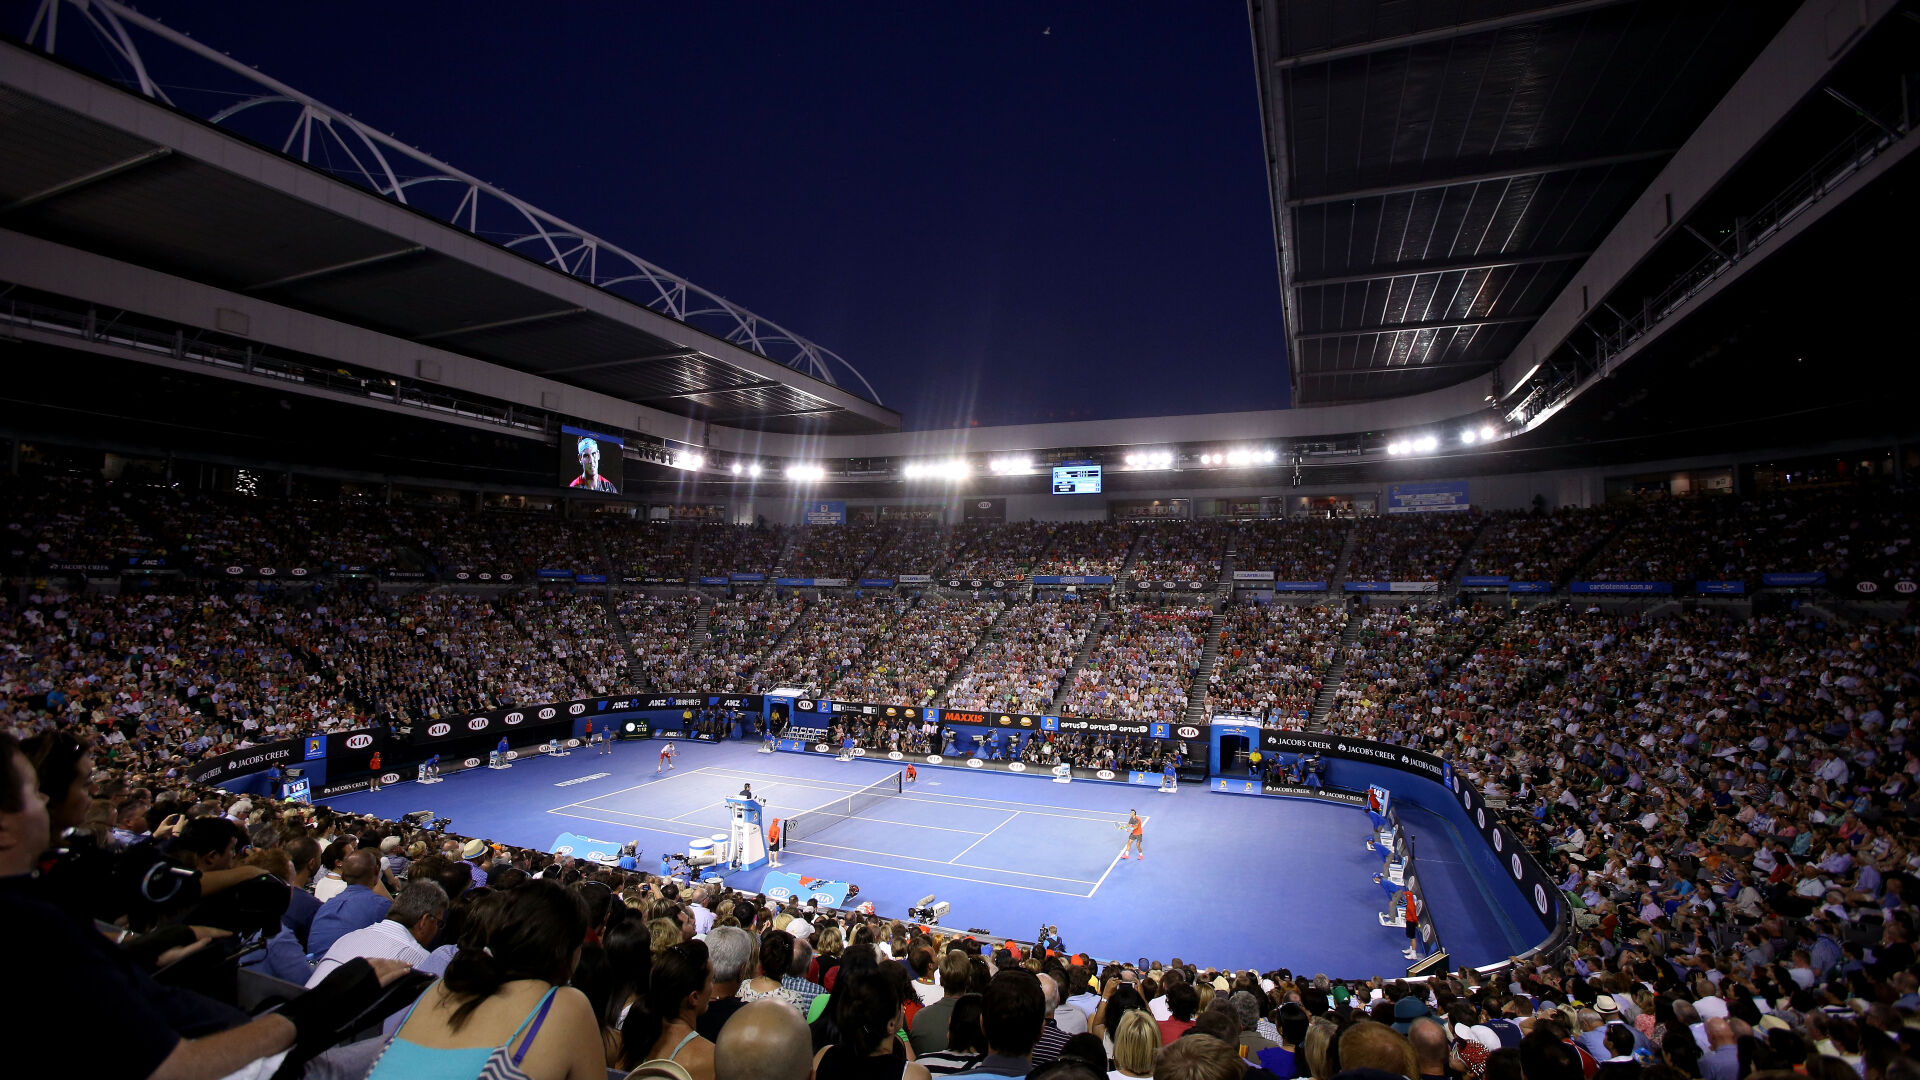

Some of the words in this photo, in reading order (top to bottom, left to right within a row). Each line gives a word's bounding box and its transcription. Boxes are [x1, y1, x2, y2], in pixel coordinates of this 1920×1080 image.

[1858, 583, 1875, 591] KIA
[1897, 583, 1914, 591] KIA
[611, 701, 630, 710] ANZ
[648, 699, 667, 707] ANZ
[723, 699, 741, 707] ANZ
[540, 709, 554, 717] KIA
[570, 705, 584, 713] KIA
[507, 714, 522, 723] KIA
[945, 712, 983, 723] MAXXIS
[470, 719, 487, 728] KIA
[1060, 721, 1081, 729] OPTUS
[1089, 724, 1110, 732] OPTUS
[1119, 725, 1140, 733] OPTUS
[431, 725, 447, 734] KIA
[1181, 728, 1197, 736] KIA
[350, 735, 371, 748] KIA
[1277, 738, 1306, 747] JACOB'S
[1307, 741, 1331, 750] CREEK
[1347, 745, 1374, 756] JACOB'S
[1375, 750, 1396, 761] CREEK
[237, 754, 264, 769] JACOB'S
[265, 749, 290, 761] CREEK
[207, 766, 222, 779] CREEK
[1429, 765, 1443, 776] CREEK
[383, 774, 398, 783] KIA
[292, 782, 304, 793] 143
